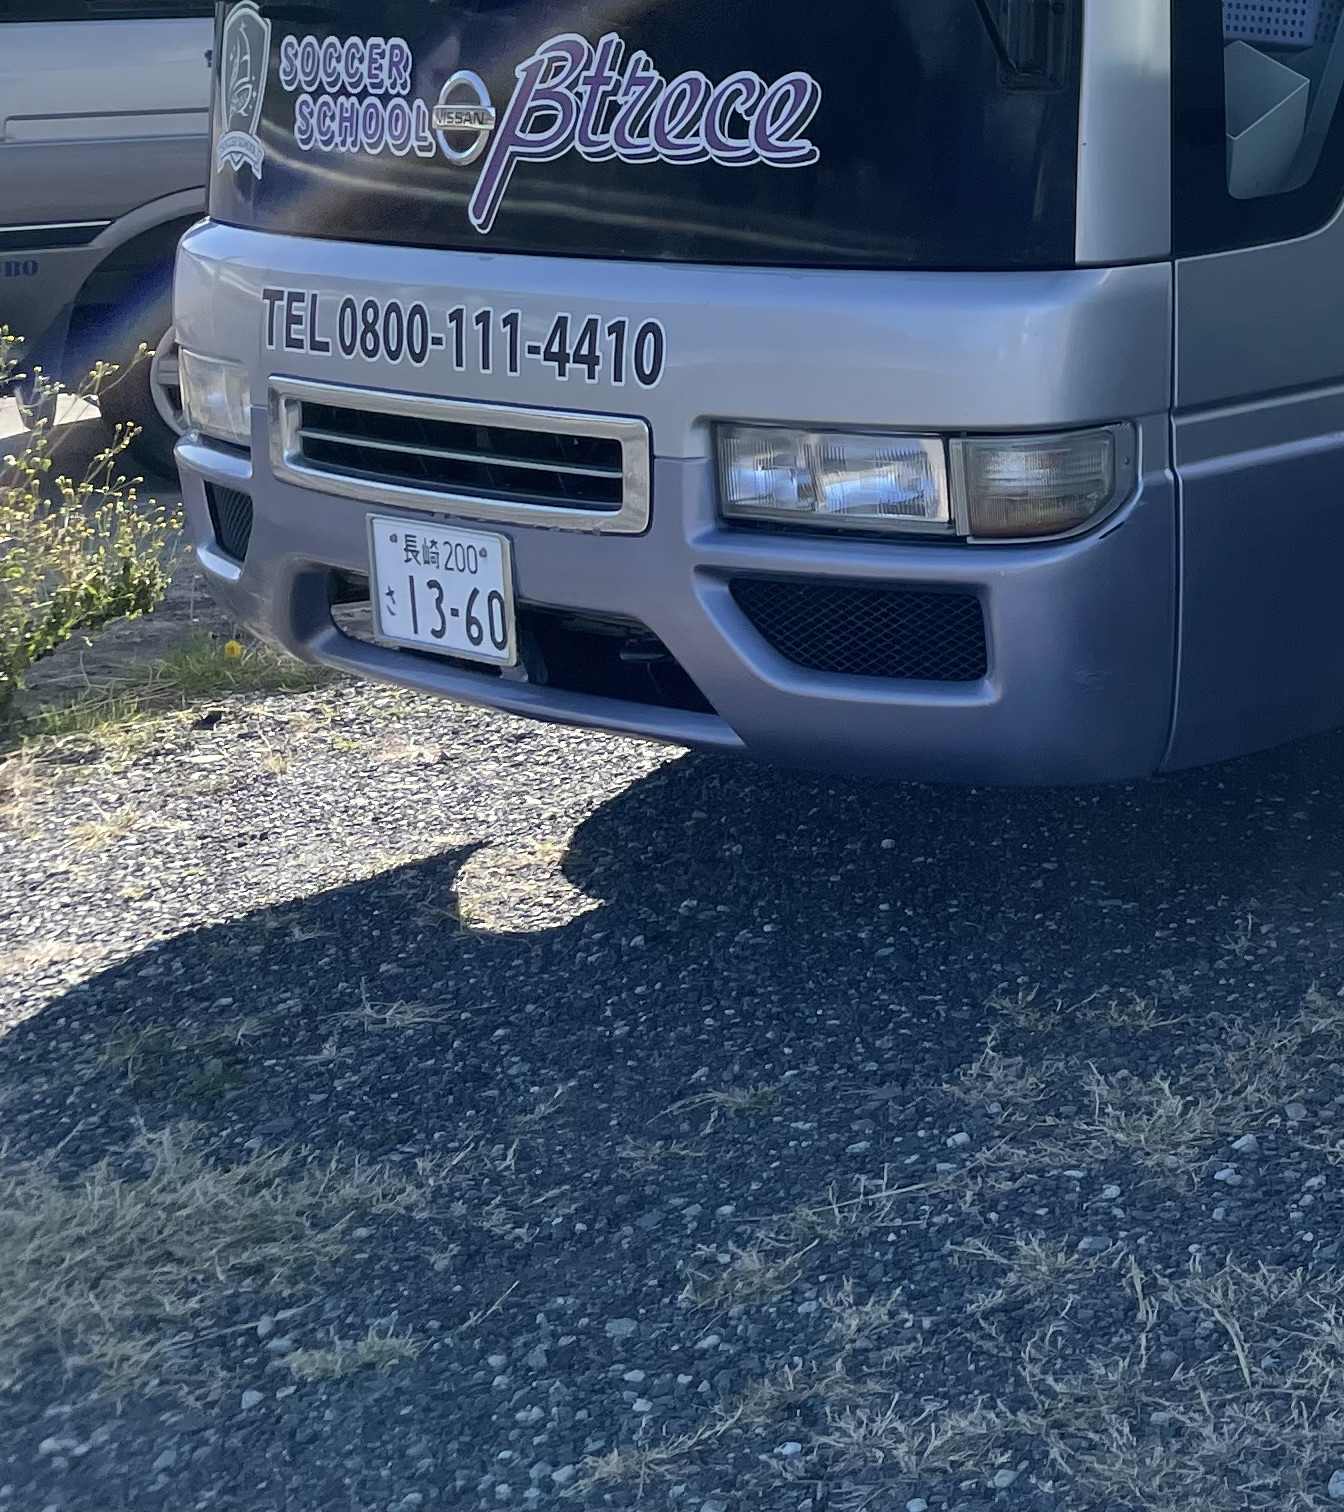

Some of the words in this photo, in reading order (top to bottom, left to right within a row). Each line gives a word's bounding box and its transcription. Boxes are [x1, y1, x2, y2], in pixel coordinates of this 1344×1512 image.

[280, 35, 412, 93] SOCCER
[297, 95, 436, 158] SCHOOL
[436, 111, 486, 125] NISSAN
[0, 260, 39, 277] BO
[262, 289, 331, 354] TEL
[338, 296, 665, 388] 0800-111-4410
[385, 586, 396, 616] さ
[408, 575, 508, 651] 13-60
